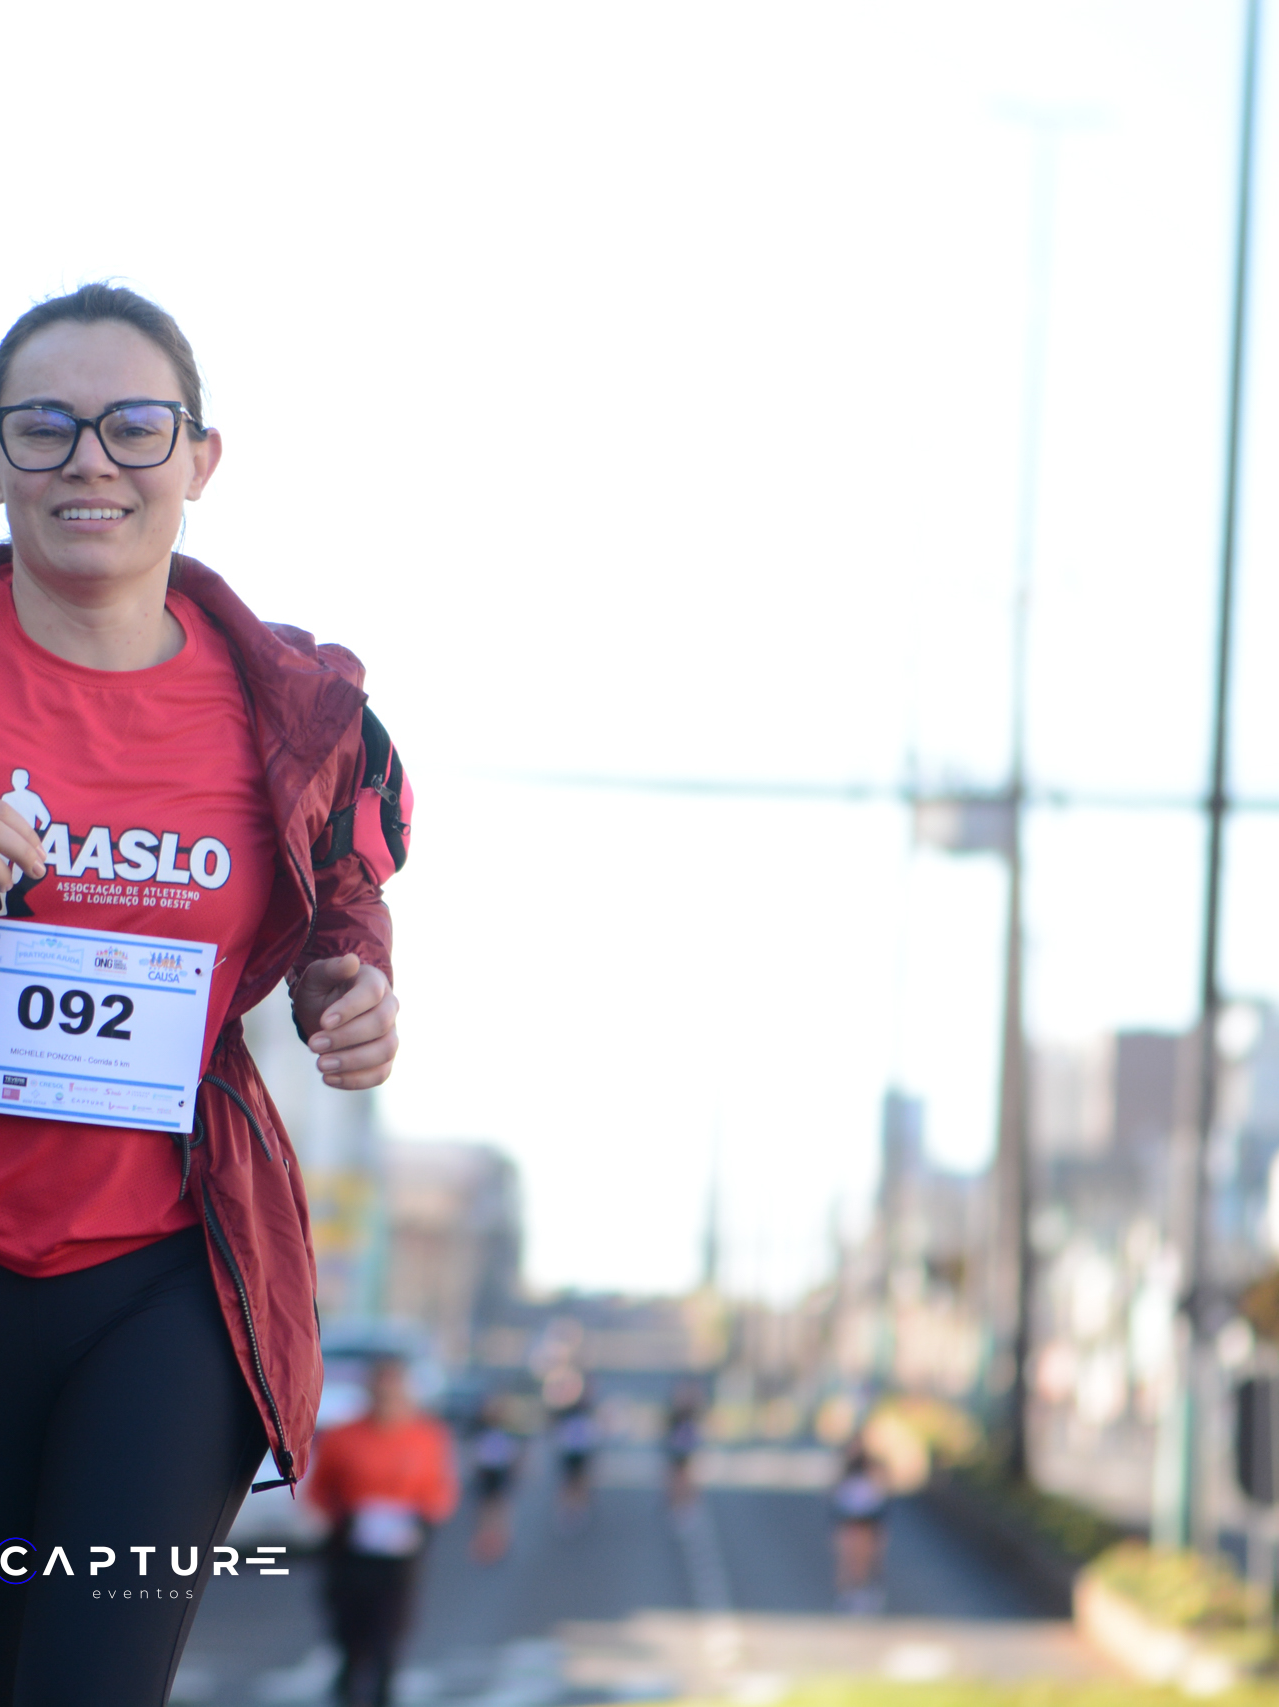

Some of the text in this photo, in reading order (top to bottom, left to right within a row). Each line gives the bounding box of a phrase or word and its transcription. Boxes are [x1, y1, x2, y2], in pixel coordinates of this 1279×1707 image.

[41, 822, 232, 890] AASLO
[56, 882, 200, 901] ASSOCIAÇÃO DE ATLETISMO
[62, 892, 191, 910] SÃO LOURENÇO DO OESTE
[18, 951, 80, 965] PRATIQUE AJUDA
[94, 956, 113, 969] ONG
[148, 970, 180, 984] CAUSA
[17, 984, 134, 1041] 092
[10, 1048, 45, 1058] MICHELE
[47, 1052, 82, 1062] PONZONI
[88, 1056, 113, 1066] Corrida
[120, 1060, 130, 1068] km
